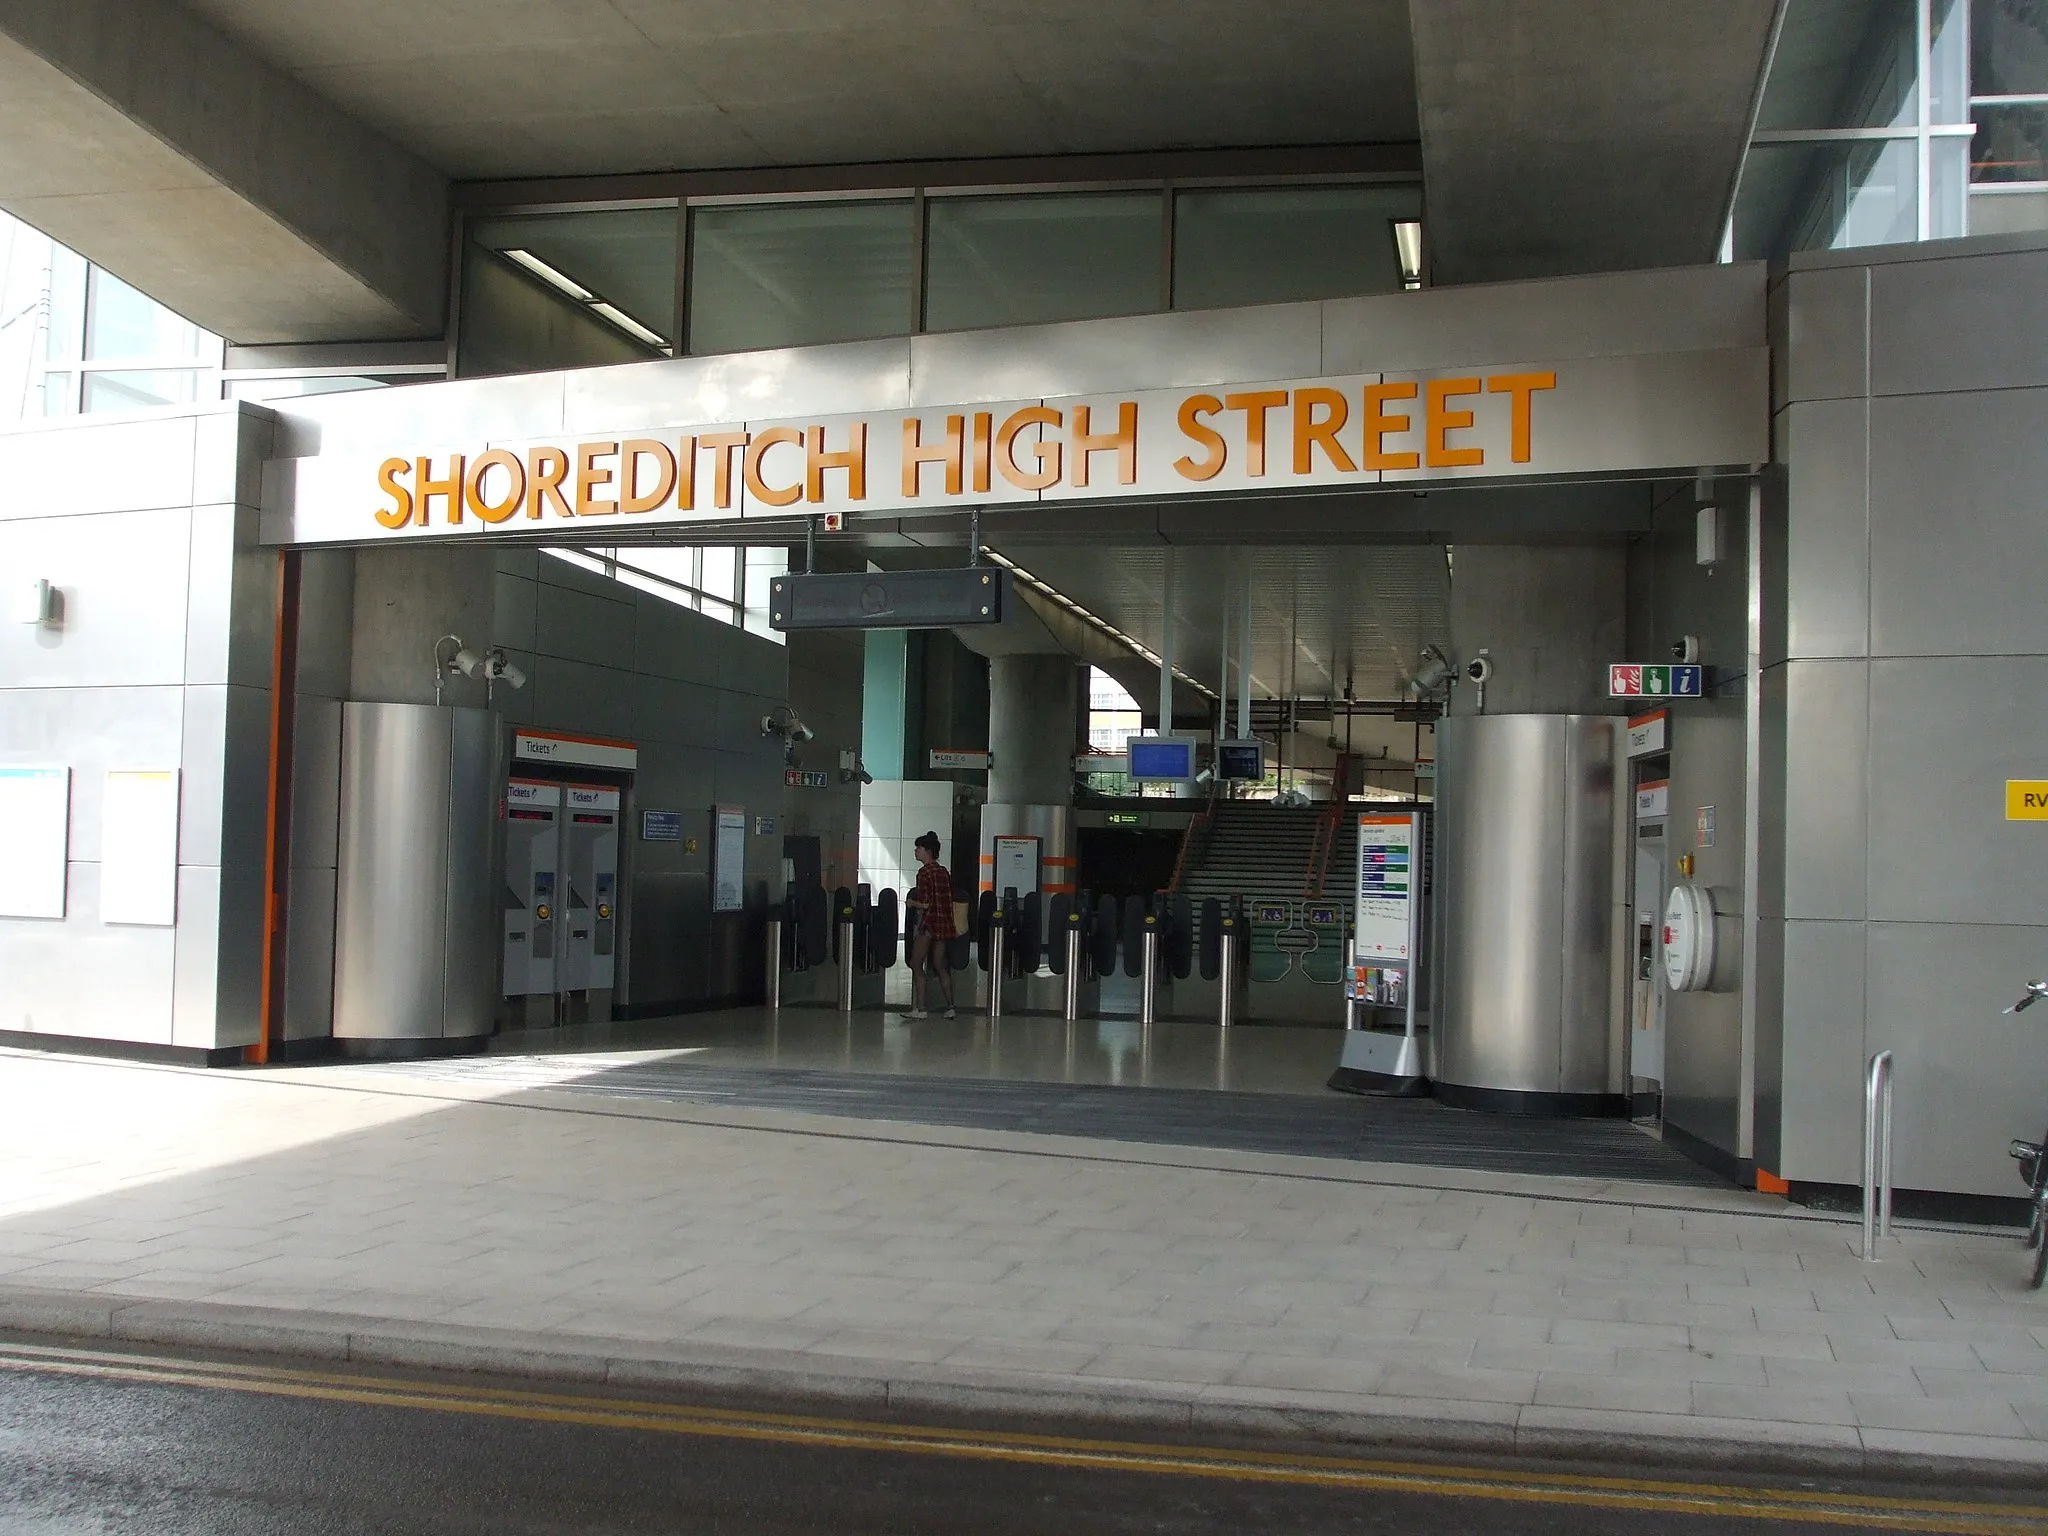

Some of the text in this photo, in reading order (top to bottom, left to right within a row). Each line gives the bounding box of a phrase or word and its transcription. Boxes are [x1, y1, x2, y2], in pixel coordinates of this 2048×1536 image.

[375, 371, 1557, 529] SHOREDITCH HIGH STREET
[525, 740, 551, 755] Tickets
[508, 786, 531, 798] Tickets
[572, 791, 593, 803] Tickets
